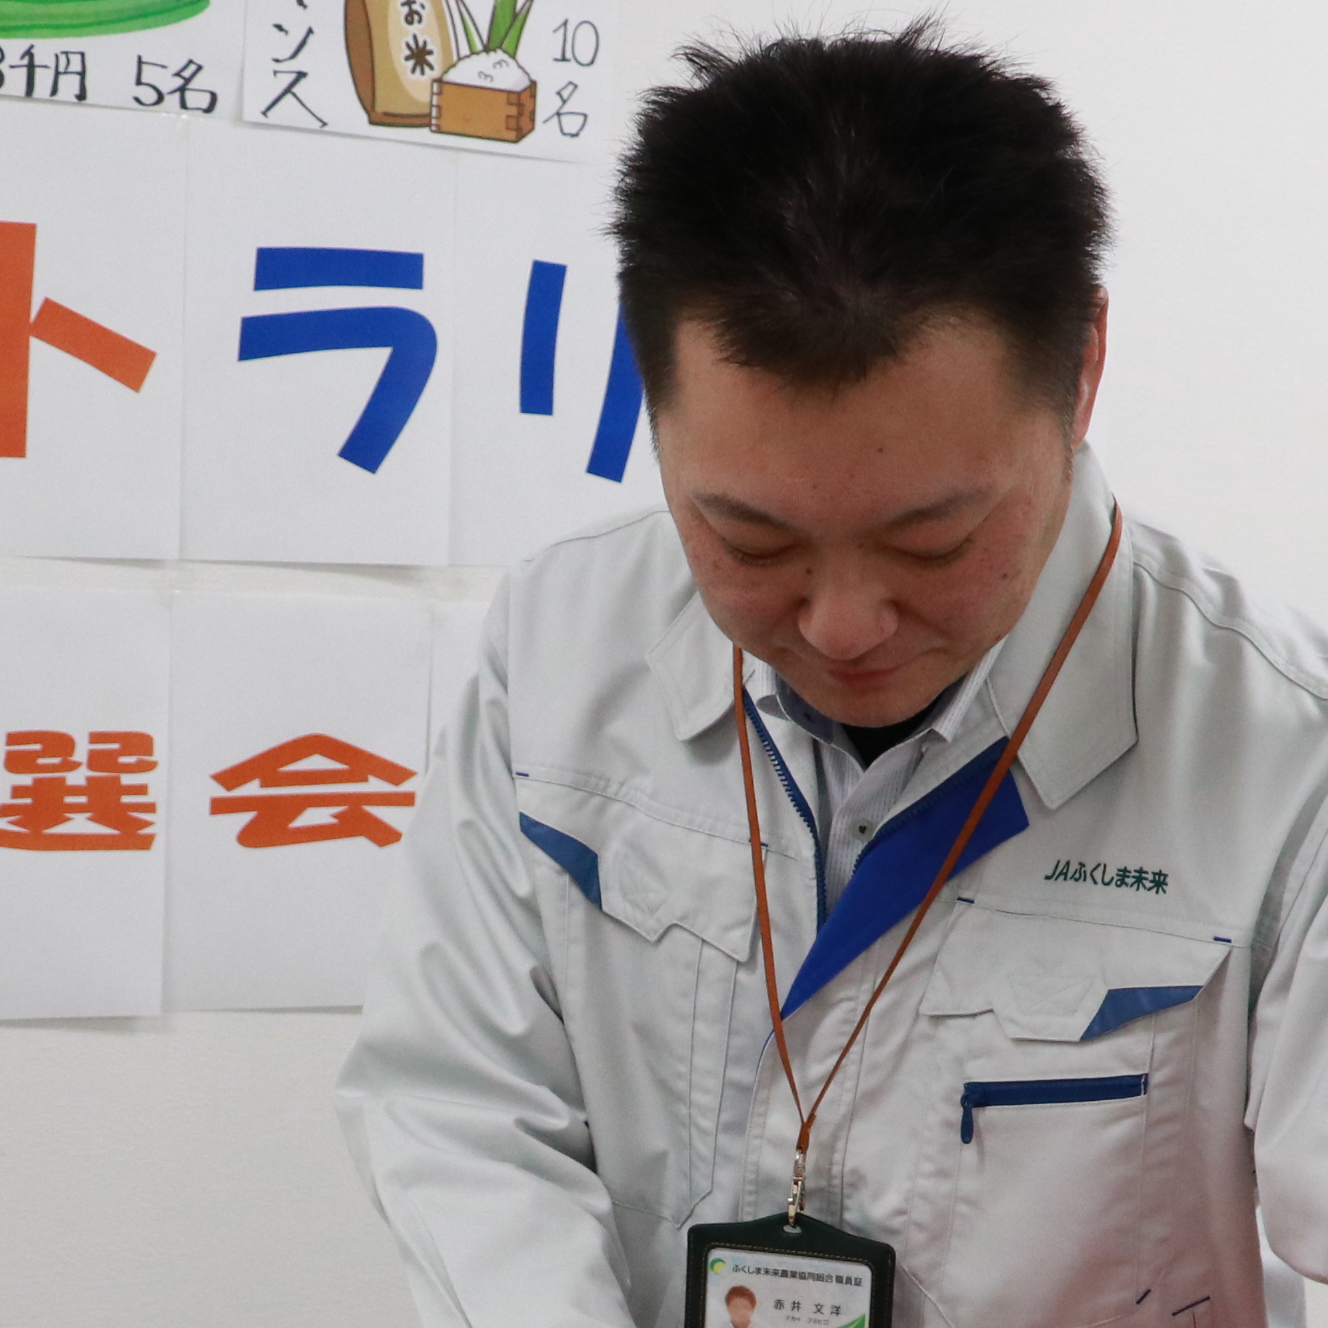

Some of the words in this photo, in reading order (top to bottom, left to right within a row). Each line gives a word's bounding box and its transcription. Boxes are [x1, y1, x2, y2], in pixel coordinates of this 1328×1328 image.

[133, 55, 218, 113] 5名
[261, 0, 327, 128] ンス
[1044, 859, 1169, 895] JAふくしま未来
